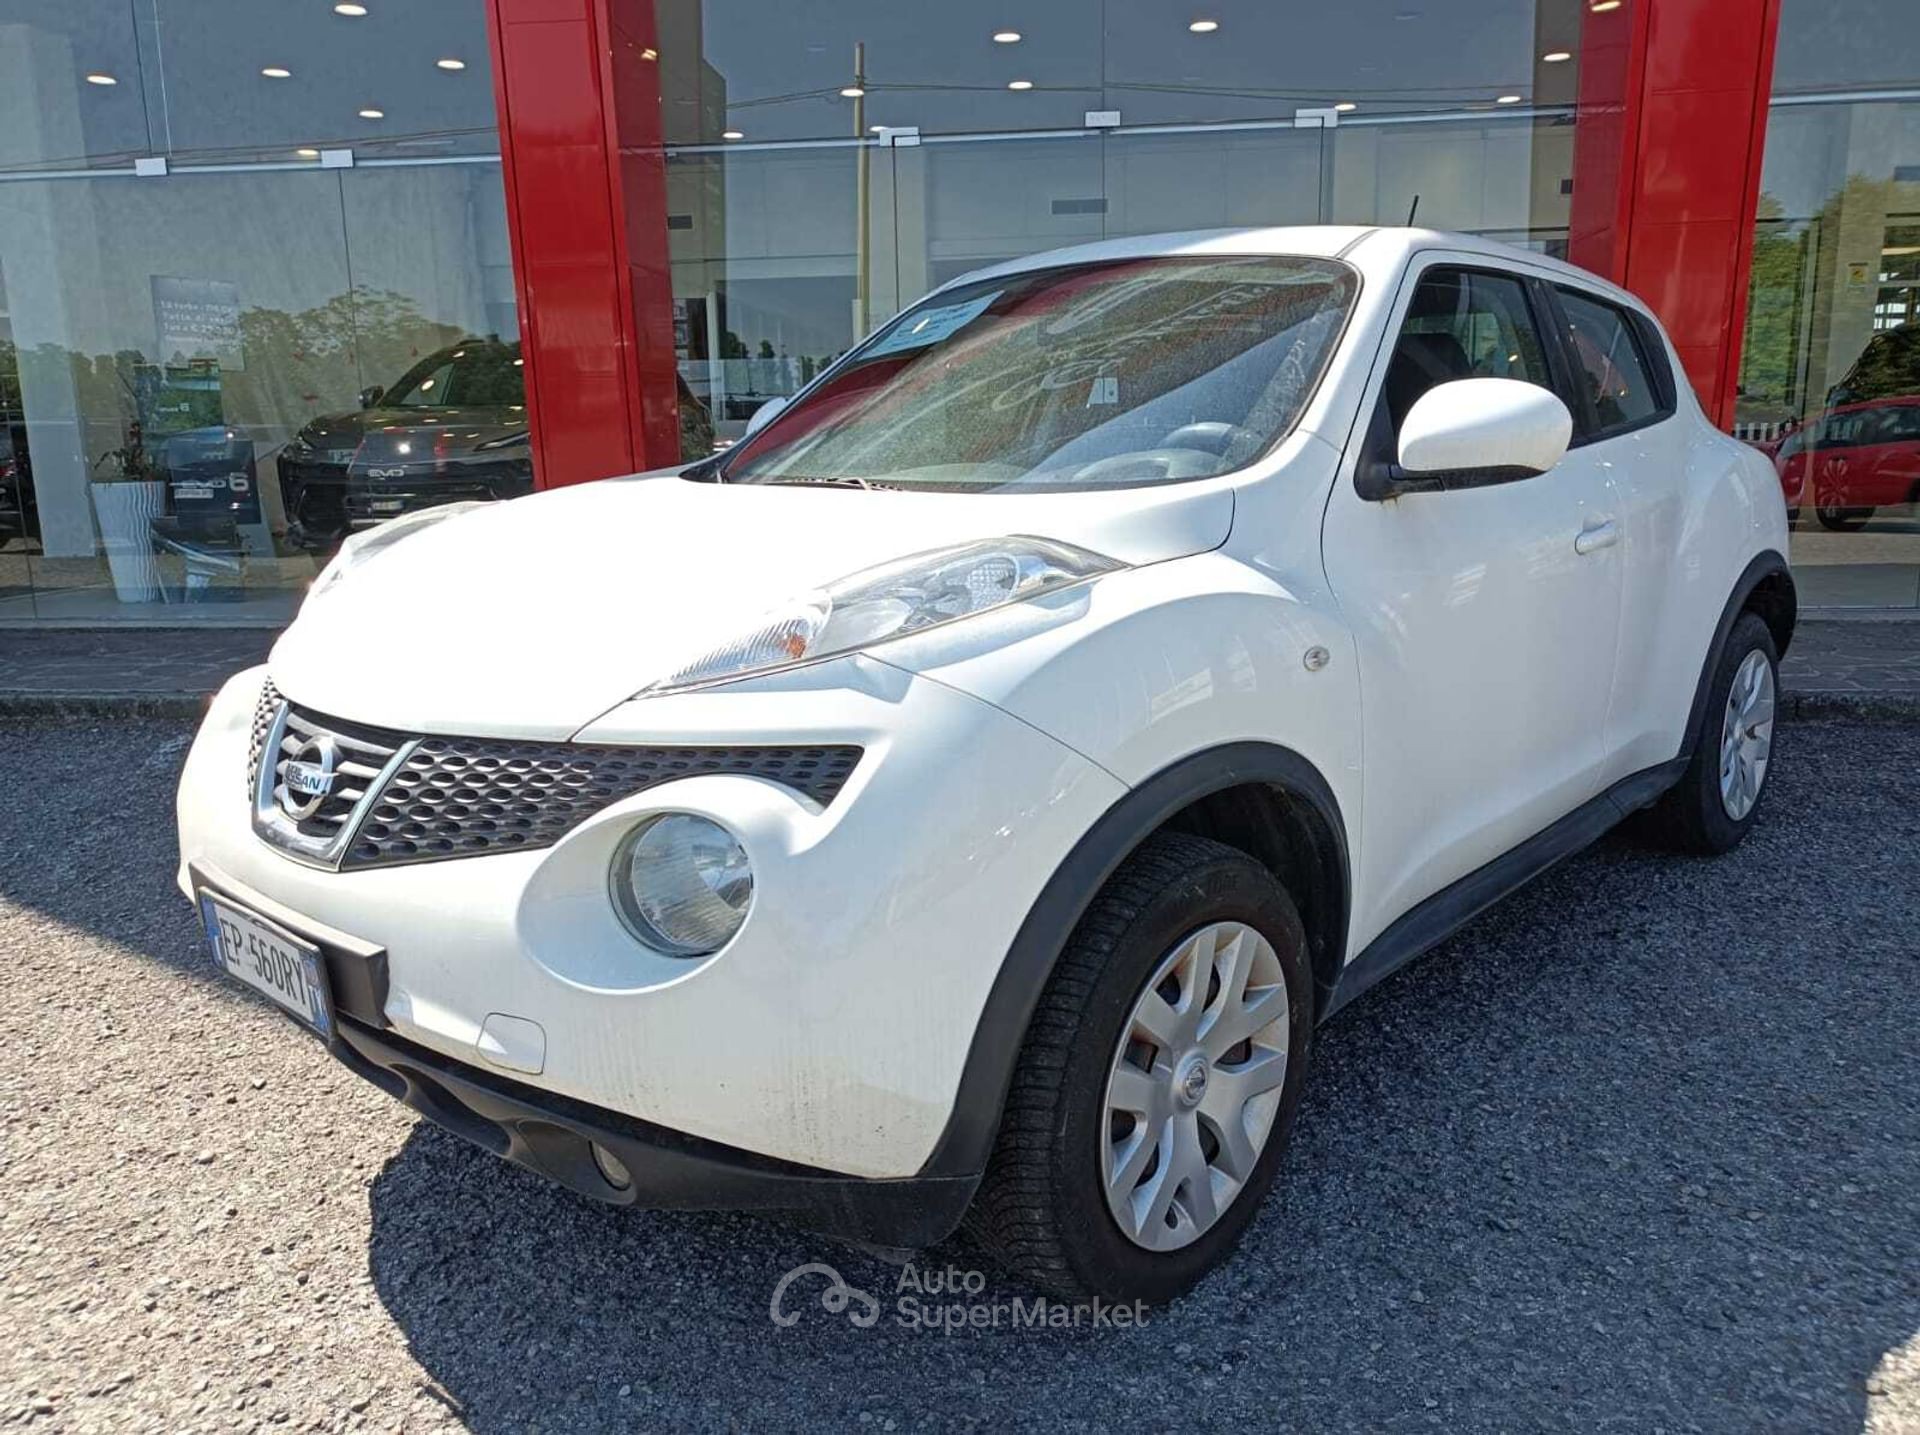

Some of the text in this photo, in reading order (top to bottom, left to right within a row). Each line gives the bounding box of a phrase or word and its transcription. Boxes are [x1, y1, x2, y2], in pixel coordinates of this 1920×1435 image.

[228, 472, 249, 492] 6
[285, 767, 321, 790] SSAN
[220, 918, 306, 1005] EP 560RY
